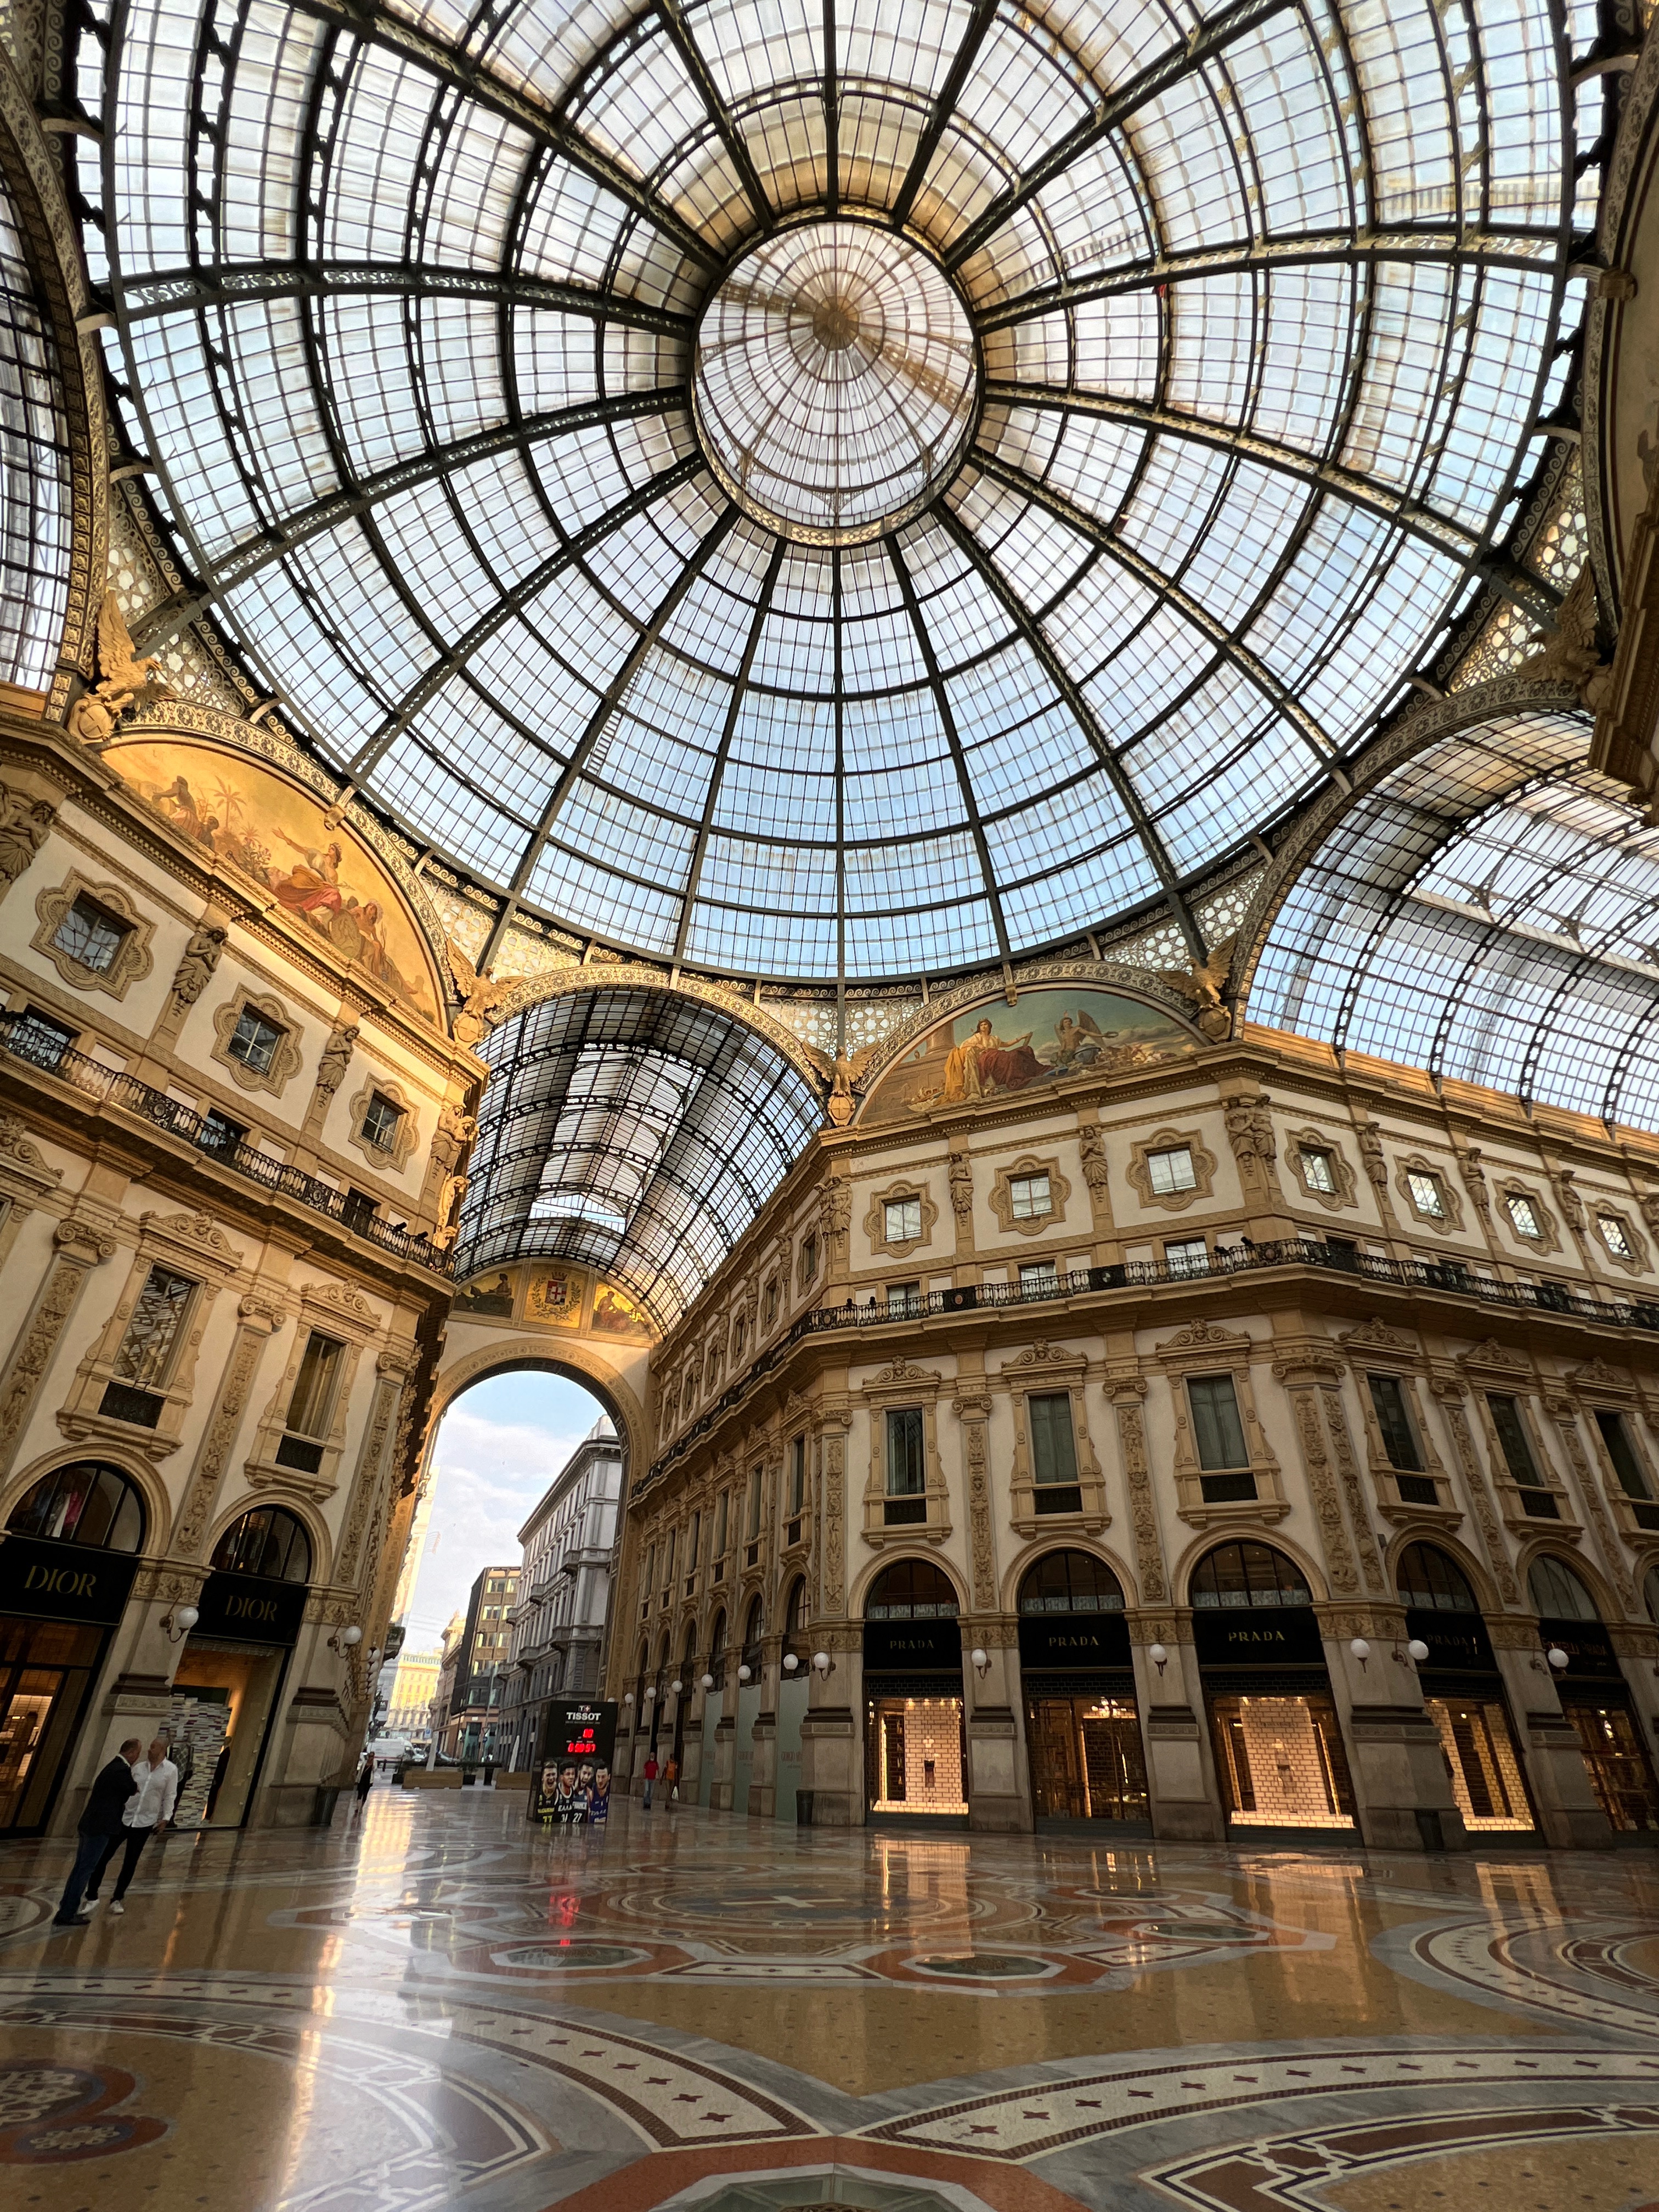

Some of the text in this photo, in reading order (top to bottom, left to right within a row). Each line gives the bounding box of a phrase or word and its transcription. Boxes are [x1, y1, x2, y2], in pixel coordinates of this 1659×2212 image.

[24, 1565, 96, 1598] DIOR
[224, 1595, 278, 1622] DIOR
[1049, 1636, 1099, 1646] PRADA
[1228, 1630, 1285, 1641] PRADA
[1426, 1634, 1469, 1646] PRADA
[890, 1640, 934, 1649] PRADA
[566, 1712, 601, 1721] TISSOT
